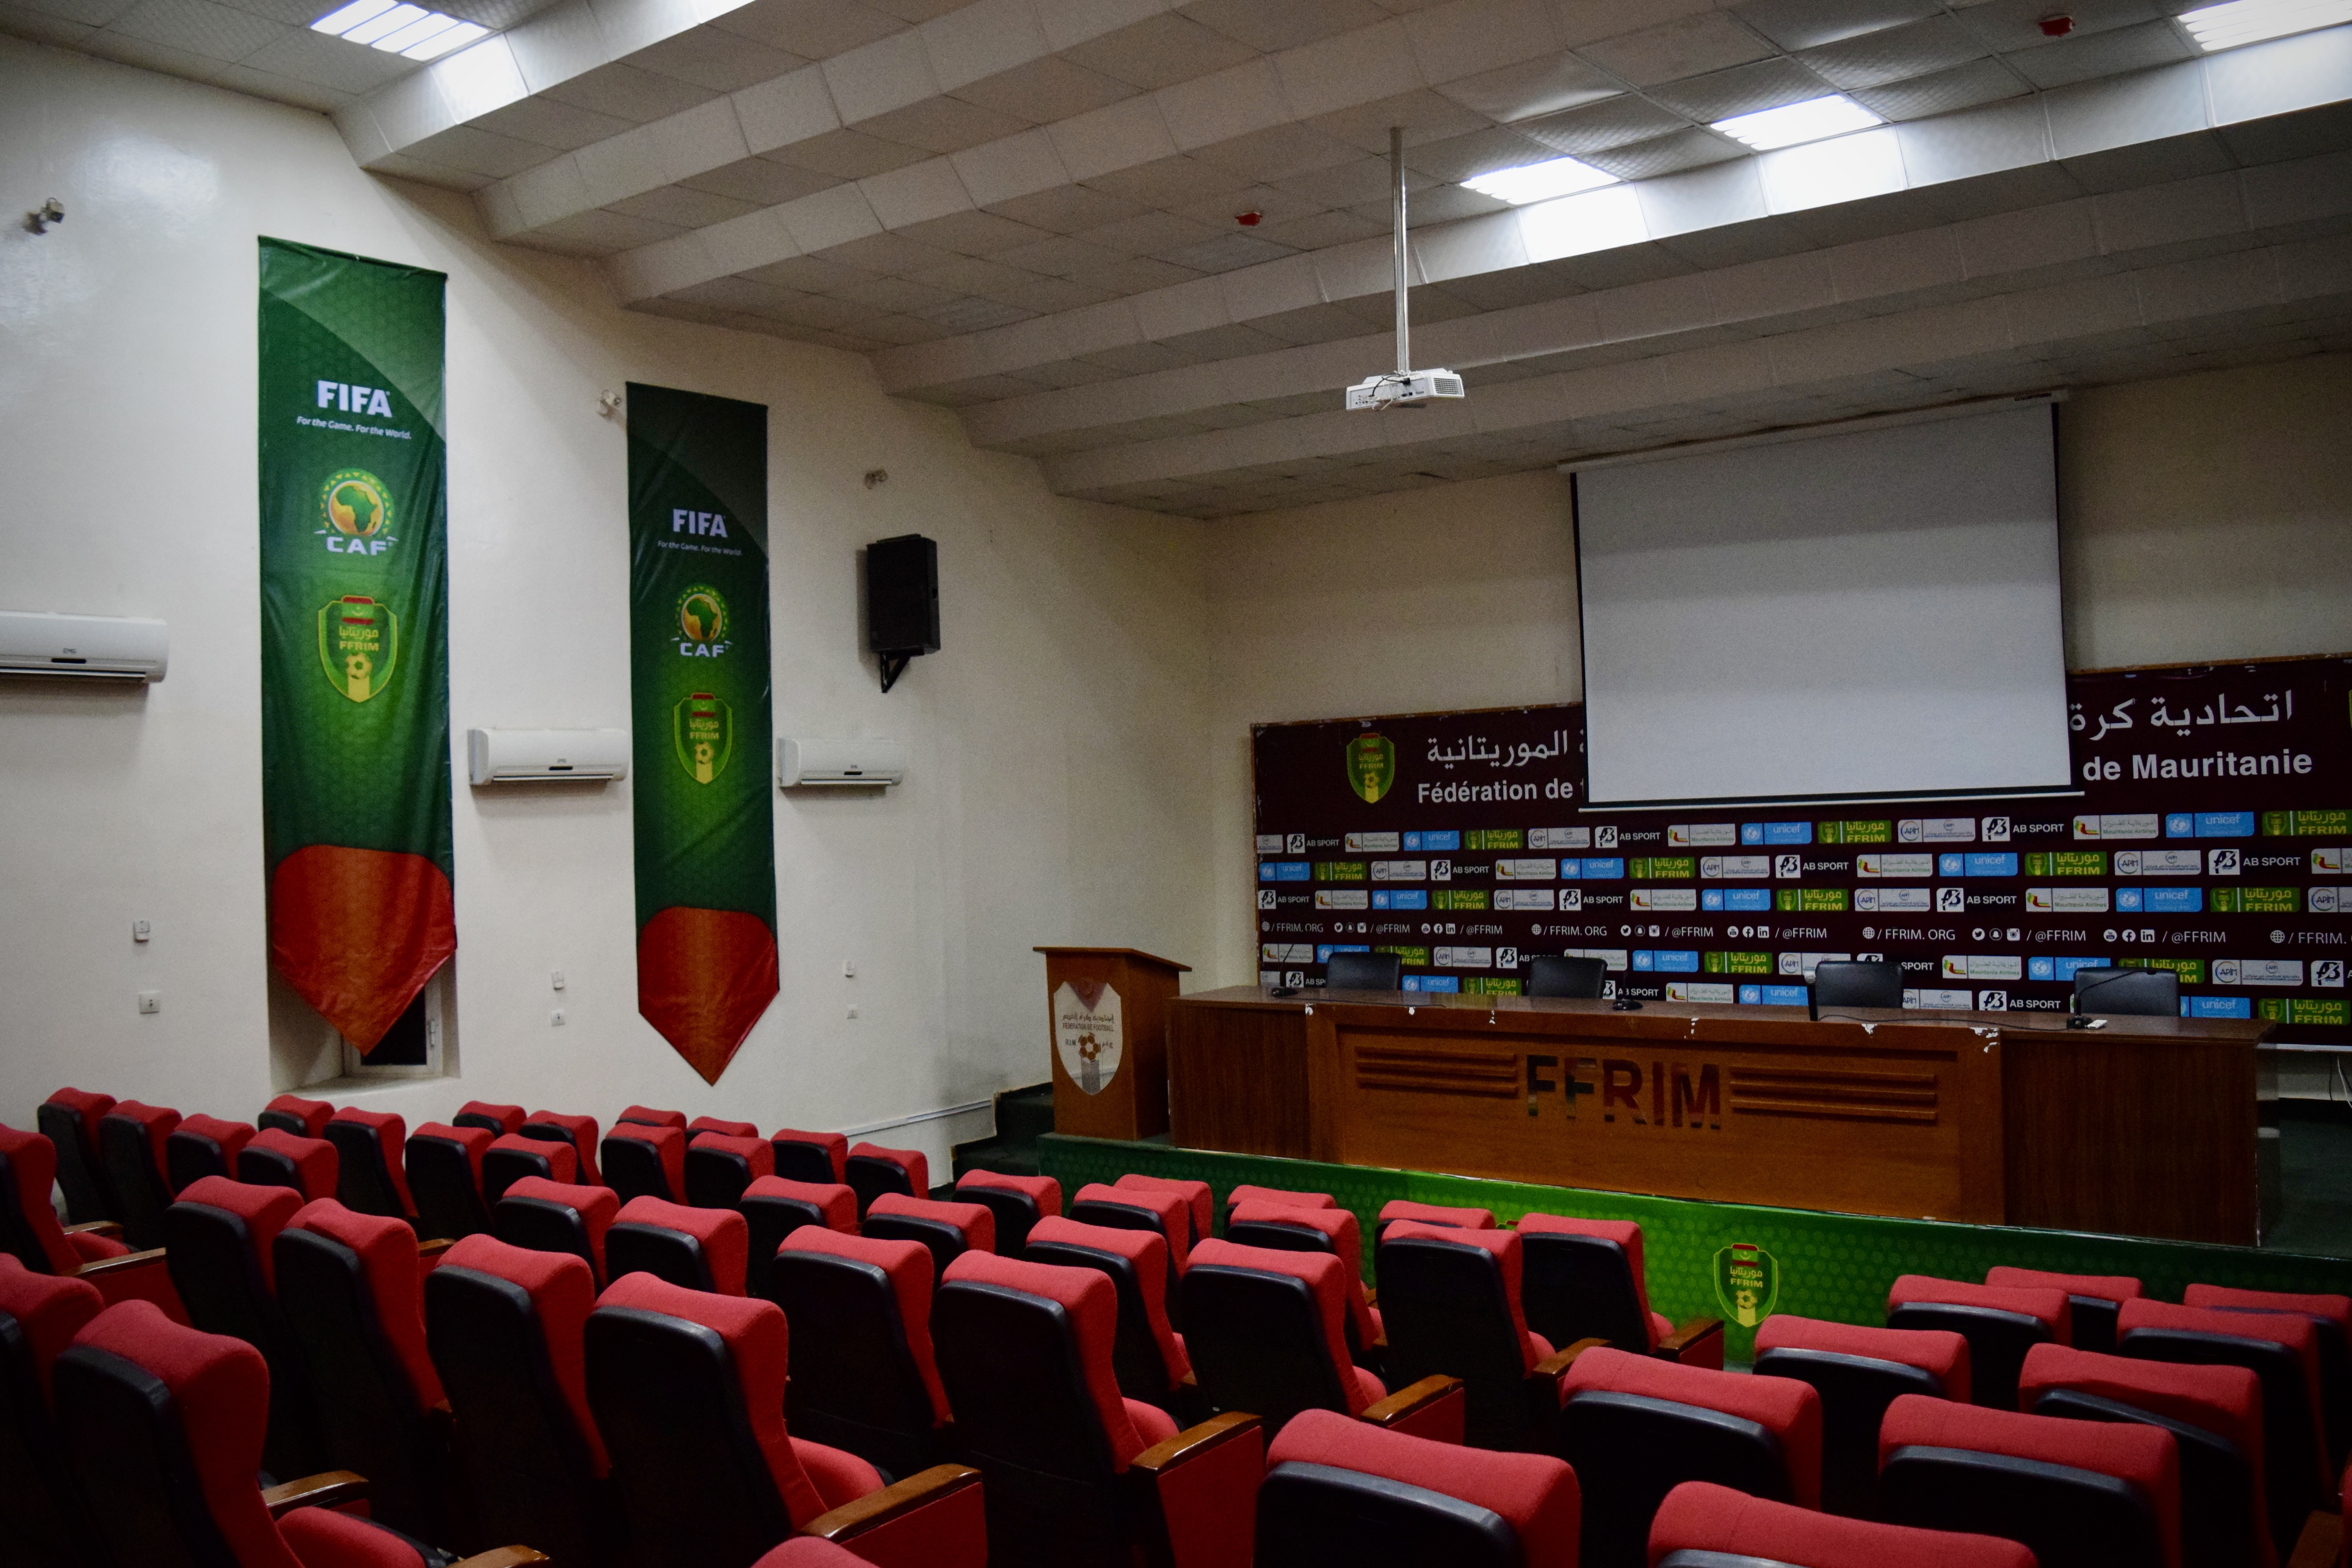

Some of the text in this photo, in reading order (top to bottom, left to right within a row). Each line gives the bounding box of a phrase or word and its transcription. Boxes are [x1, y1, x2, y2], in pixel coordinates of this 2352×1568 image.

[318, 380, 392, 417] FIFA
[297, 416, 411, 439] For the Game. For the World.
[673, 509, 728, 538] FIFA
[327, 536, 387, 555] CAF
[339, 641, 379, 650] FFRIM
[680, 642, 724, 657] CAF
[2069, 690, 2292, 740] اتحادية كرة
[1428, 730, 1567, 769] الموريتانية
[2083, 749, 2312, 780] de Mauritanie
[1418, 779, 1537, 803] Fédération
[1546, 778, 1573, 799] de
[2206, 814, 2239, 824] unicef
[1773, 824, 1800, 833] unicef
[2013, 824, 2064, 833] AB SPORT
[2299, 826, 2346, 835] FFRIM
[1975, 855, 2005, 864] unicef
[2243, 857, 2301, 866] AB SPORT
[1733, 891, 1759, 900] unicef
[2155, 889, 2188, 900] unicef
[1983, 896, 2016, 904] SPORT
[2246, 903, 2292, 911] FFRIM
[1305, 923, 1323, 932] ORG
[1376, 924, 1410, 933] @FFRIM
[1466, 925, 1502, 935] @FFRIM
[1585, 926, 1607, 936] ORG
[1672, 927, 1713, 937] @FFRIM
[1782, 927, 1827, 939] @FFRIM
[1928, 929, 1955, 940] ORG
[2035, 930, 2085, 942] @FFRIM
[2171, 931, 2226, 943] @FFRIM
[1902, 962, 1934, 970] SPORT
[2065, 960, 2098, 968] unicef
[1428, 978, 1449, 986] unicef
[1771, 987, 1797, 996] unicef
[2026, 1000, 2061, 1009] SPORT
[2202, 999, 2236, 1009] unicef
[2295, 1016, 2342, 1024] FFRIM
[1526, 1054, 1721, 1130] FFRIM
[1731, 1278, 1763, 1288] FFRIM
